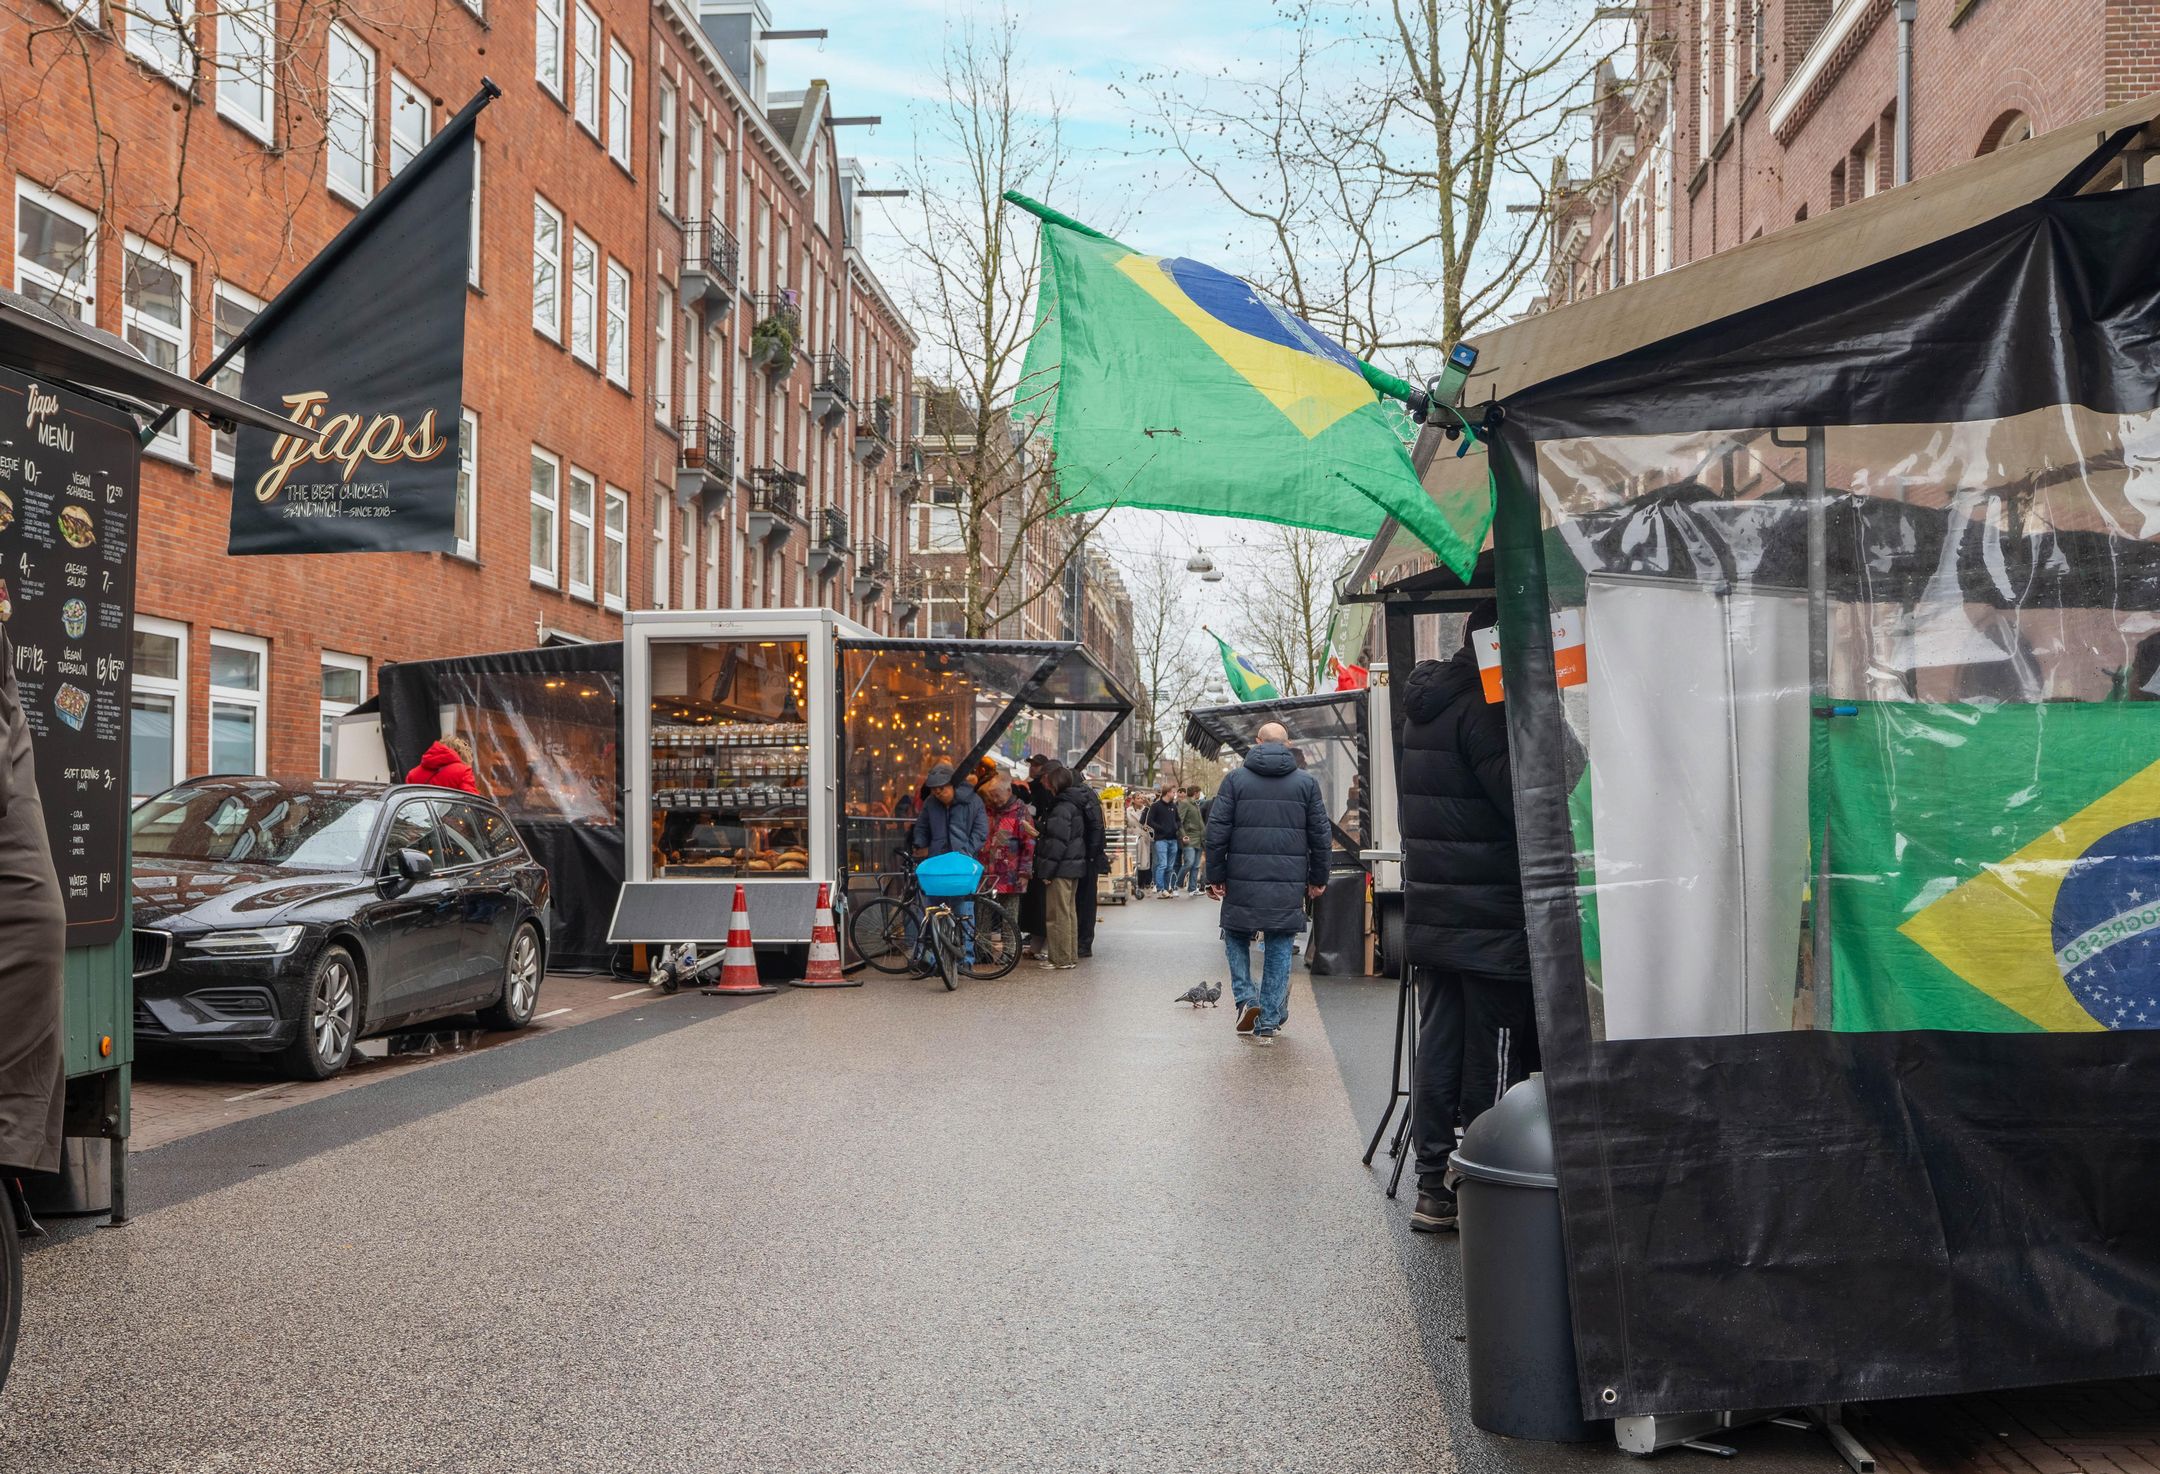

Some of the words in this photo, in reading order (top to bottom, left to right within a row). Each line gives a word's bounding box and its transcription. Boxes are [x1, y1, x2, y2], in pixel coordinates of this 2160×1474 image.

[26, 383, 59, 428] Tjaps
[38, 422, 74, 454] MENU
[256, 390, 447, 504] Tjaps
[72, 471, 91, 488] VEGAN
[284, 484, 309, 500] THE
[311, 483, 338, 500] BEST
[339, 480, 390, 500] CHICKEN
[282, 500, 342, 518] SANDWICH
[64, 562, 88, 576] CAESAR
[66, 575, 86, 588] SALAD
[64, 646, 82, 661] VEGAN
[64, 768, 79, 780] SOFT
[80, 766, 100, 780] DRINKS
[69, 874, 88, 886] WATER
